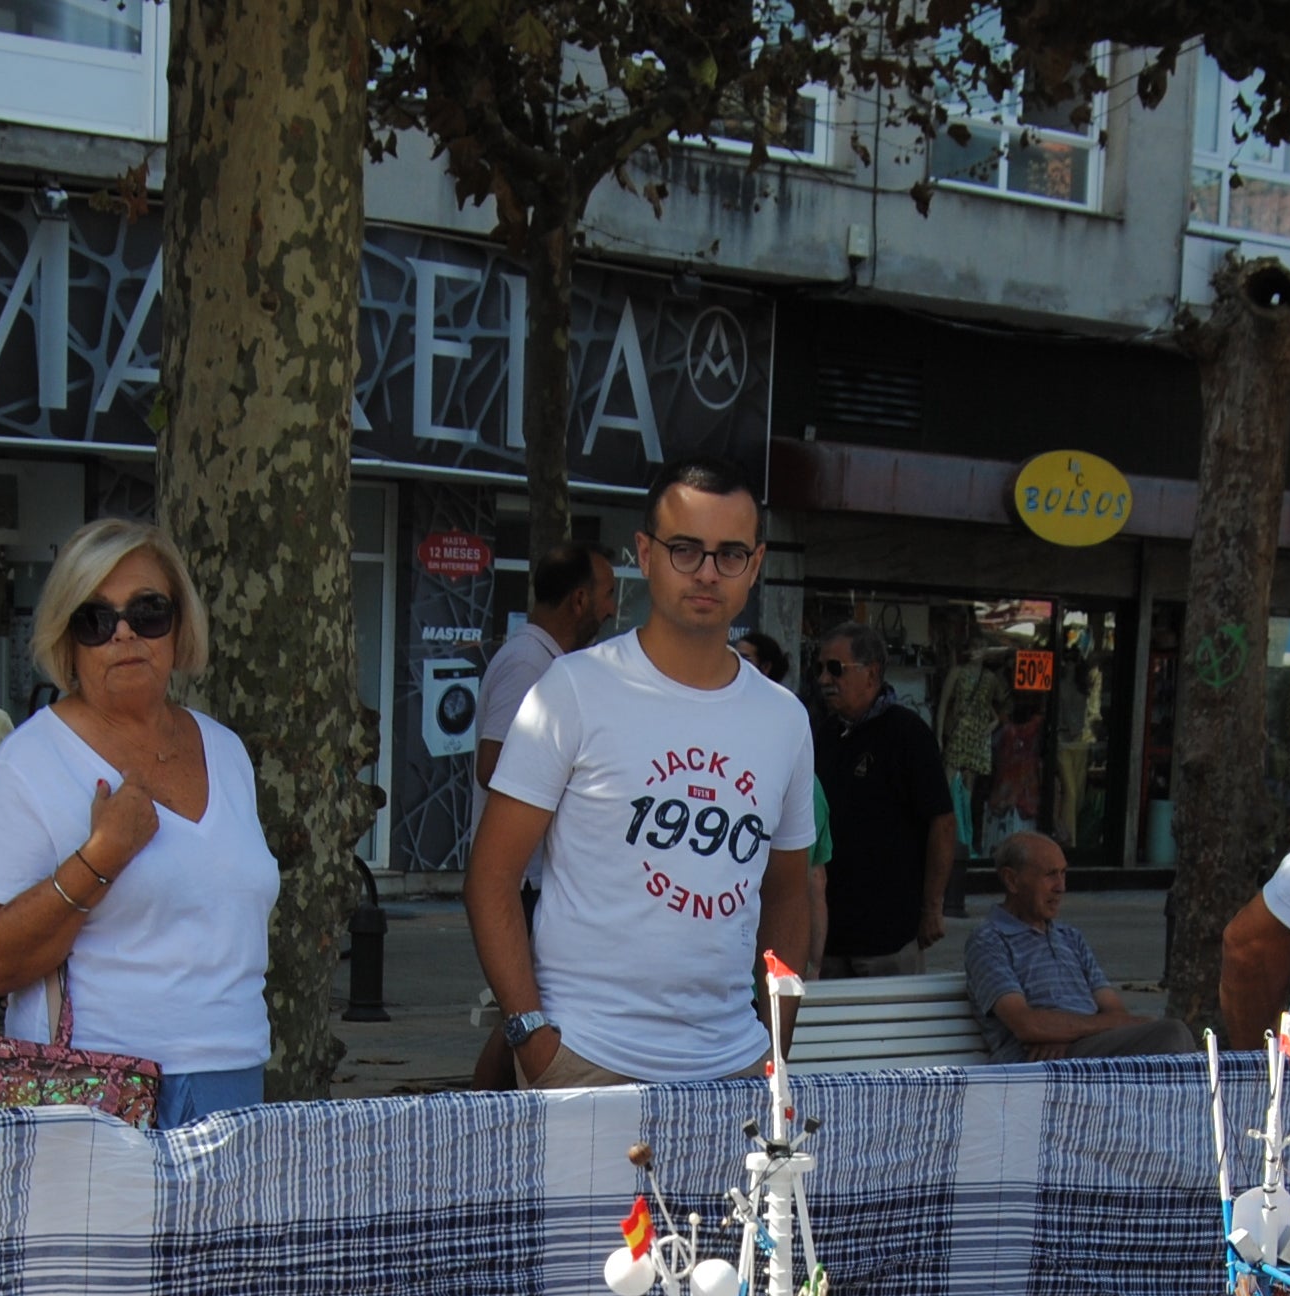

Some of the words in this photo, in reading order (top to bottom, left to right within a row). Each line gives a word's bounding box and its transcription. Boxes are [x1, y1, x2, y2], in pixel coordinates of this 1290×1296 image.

[1025, 486, 1126, 519] BOLSOS
[442, 536, 468, 546] HASTA
[429, 547, 441, 558] 12
[444, 548, 480, 560] MESES
[441, 562, 479, 571] INTERESES
[422, 626, 482, 642] MASTER
[1017, 659, 1051, 688] 50%
[625, 795, 771, 864] 1990
